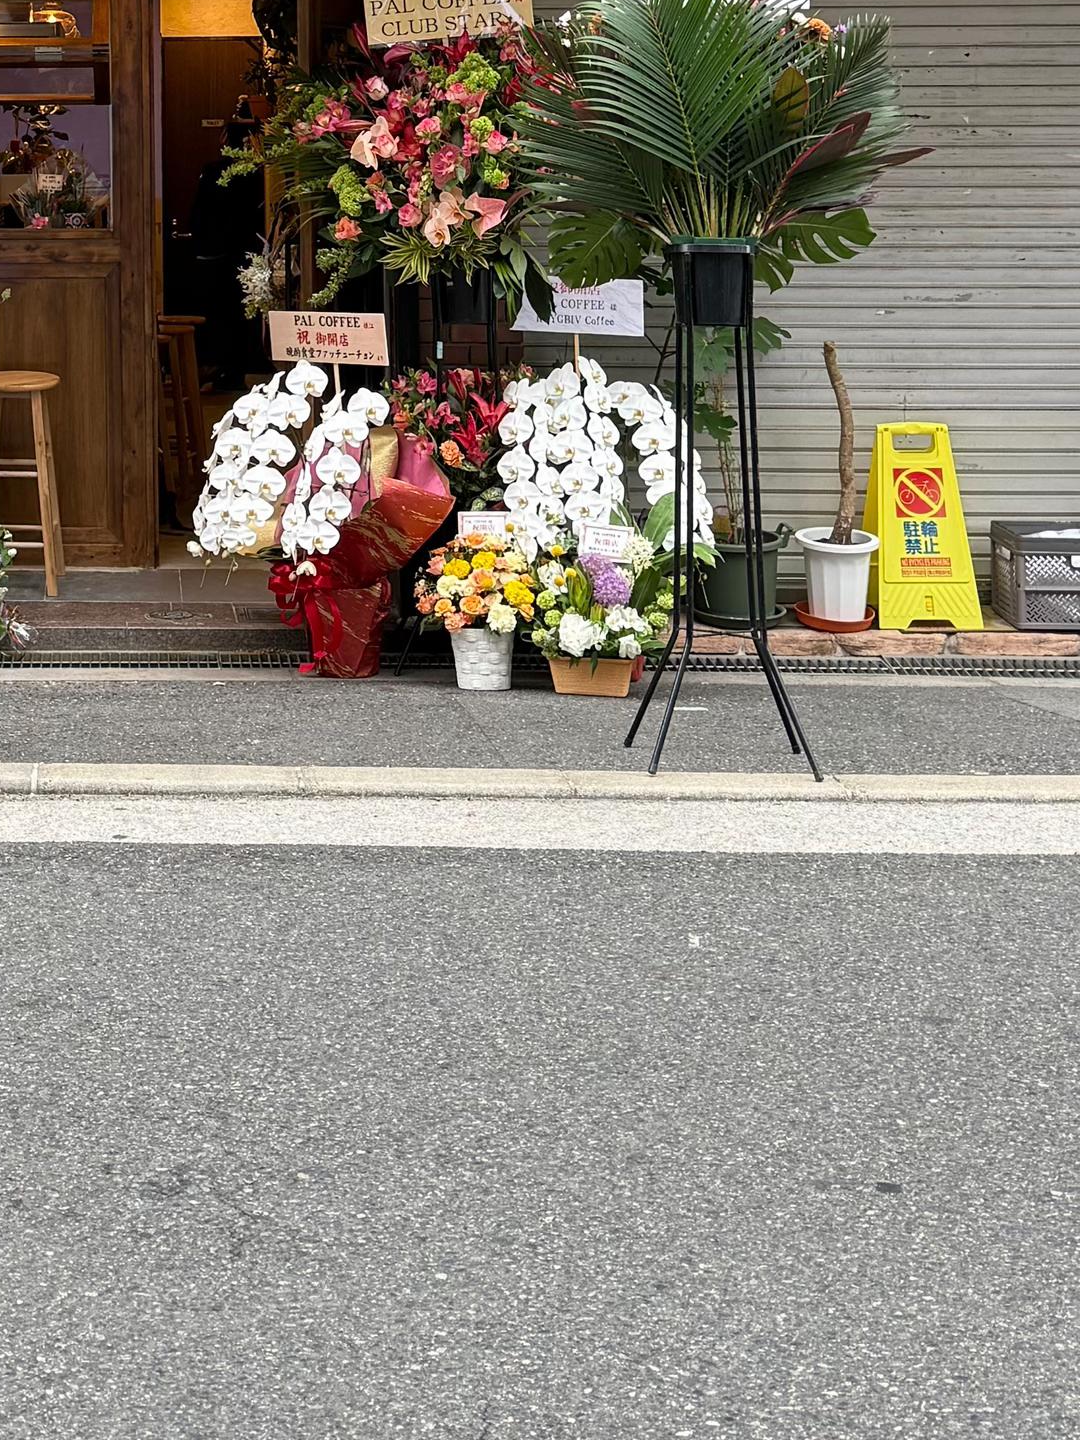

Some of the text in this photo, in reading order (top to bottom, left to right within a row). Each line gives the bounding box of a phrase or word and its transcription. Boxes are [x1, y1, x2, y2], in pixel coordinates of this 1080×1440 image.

[381, 17, 438, 37] CLUB
[561, 298, 605, 310] COFFEE
[294, 315, 315, 327] PAL
[318, 315, 361, 329] COFFEE
[584, 314, 615, 327] Coffee
[903, 520, 938, 537] 駐輪
[904, 538, 940, 555] 禁止
